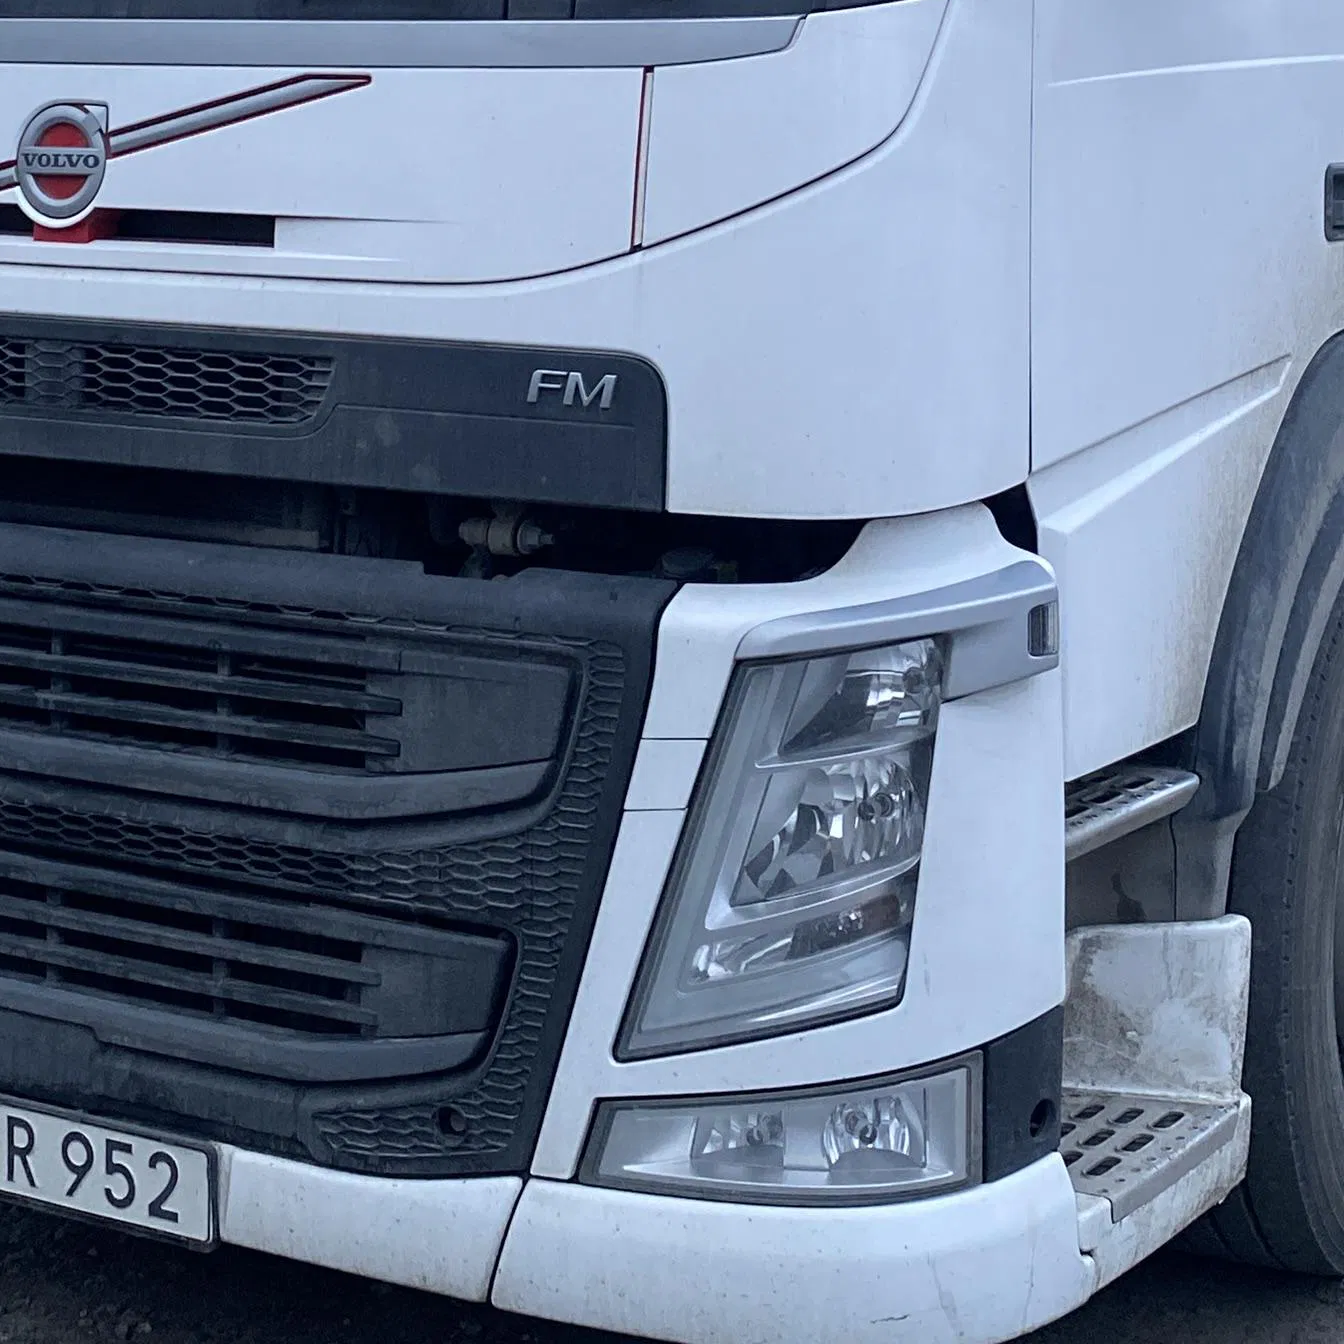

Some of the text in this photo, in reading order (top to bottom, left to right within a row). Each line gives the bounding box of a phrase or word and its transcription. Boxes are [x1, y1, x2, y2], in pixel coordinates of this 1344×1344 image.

[21, 153, 100, 169] VOLVO
[526, 368, 618, 409] FM
[60, 1130, 180, 1224] 952
